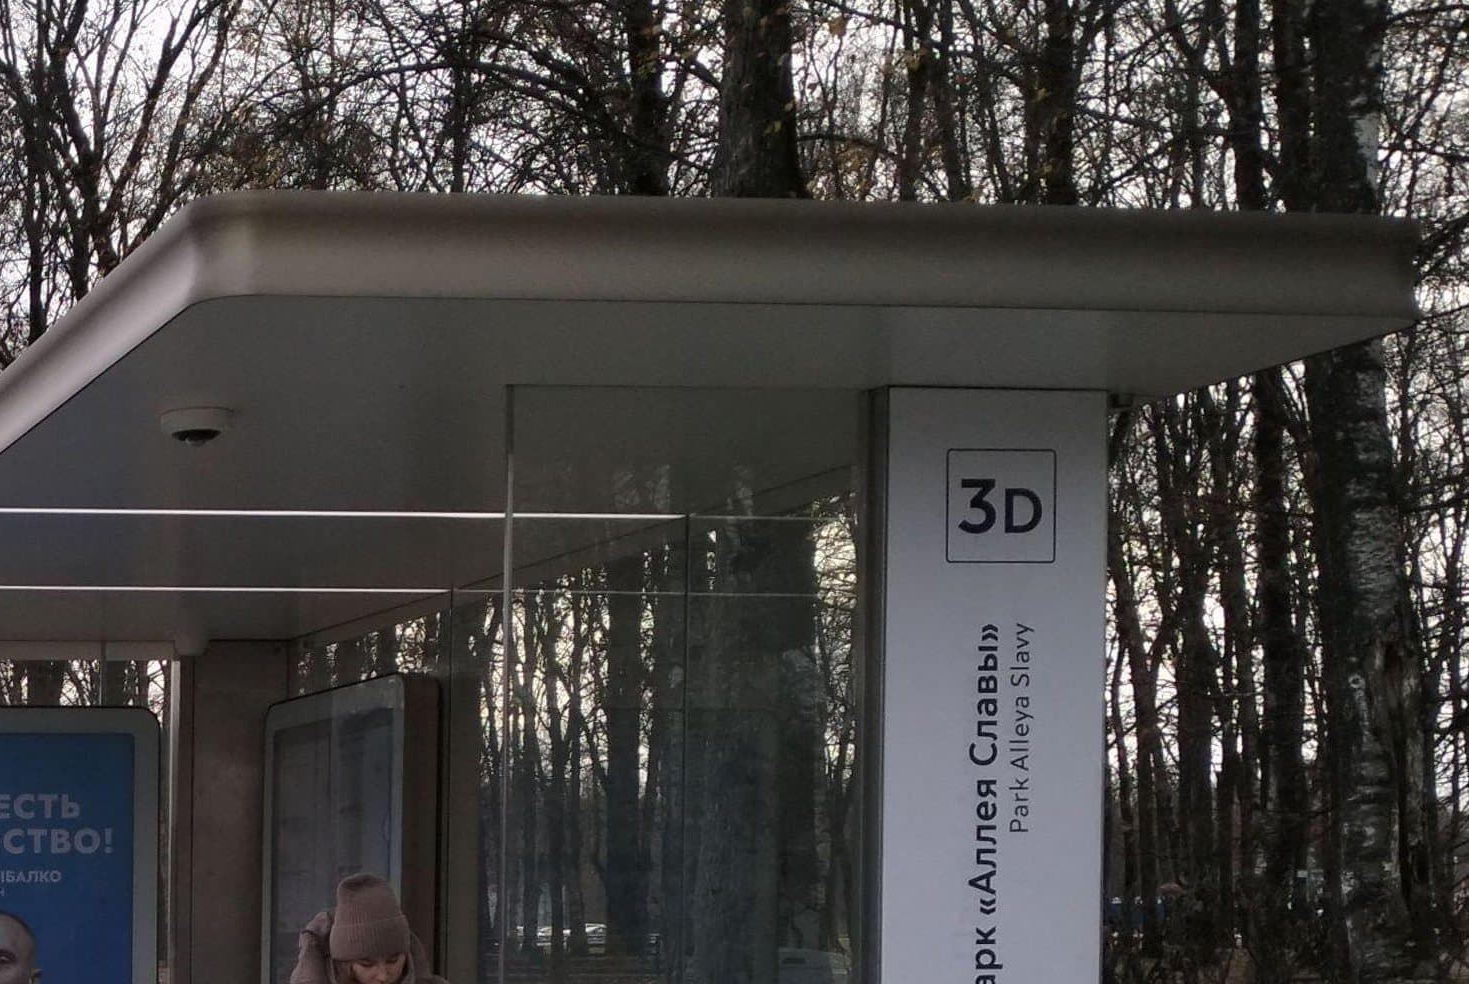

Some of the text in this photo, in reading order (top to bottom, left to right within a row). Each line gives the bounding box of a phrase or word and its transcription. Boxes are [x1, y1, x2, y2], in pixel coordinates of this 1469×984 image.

[958, 478, 1043, 534] 3D
[968, 624, 999, 767] Славы»
[1008, 622, 1035, 833] Park Alleya Slavy
[967, 779, 998, 916] «Аллея
